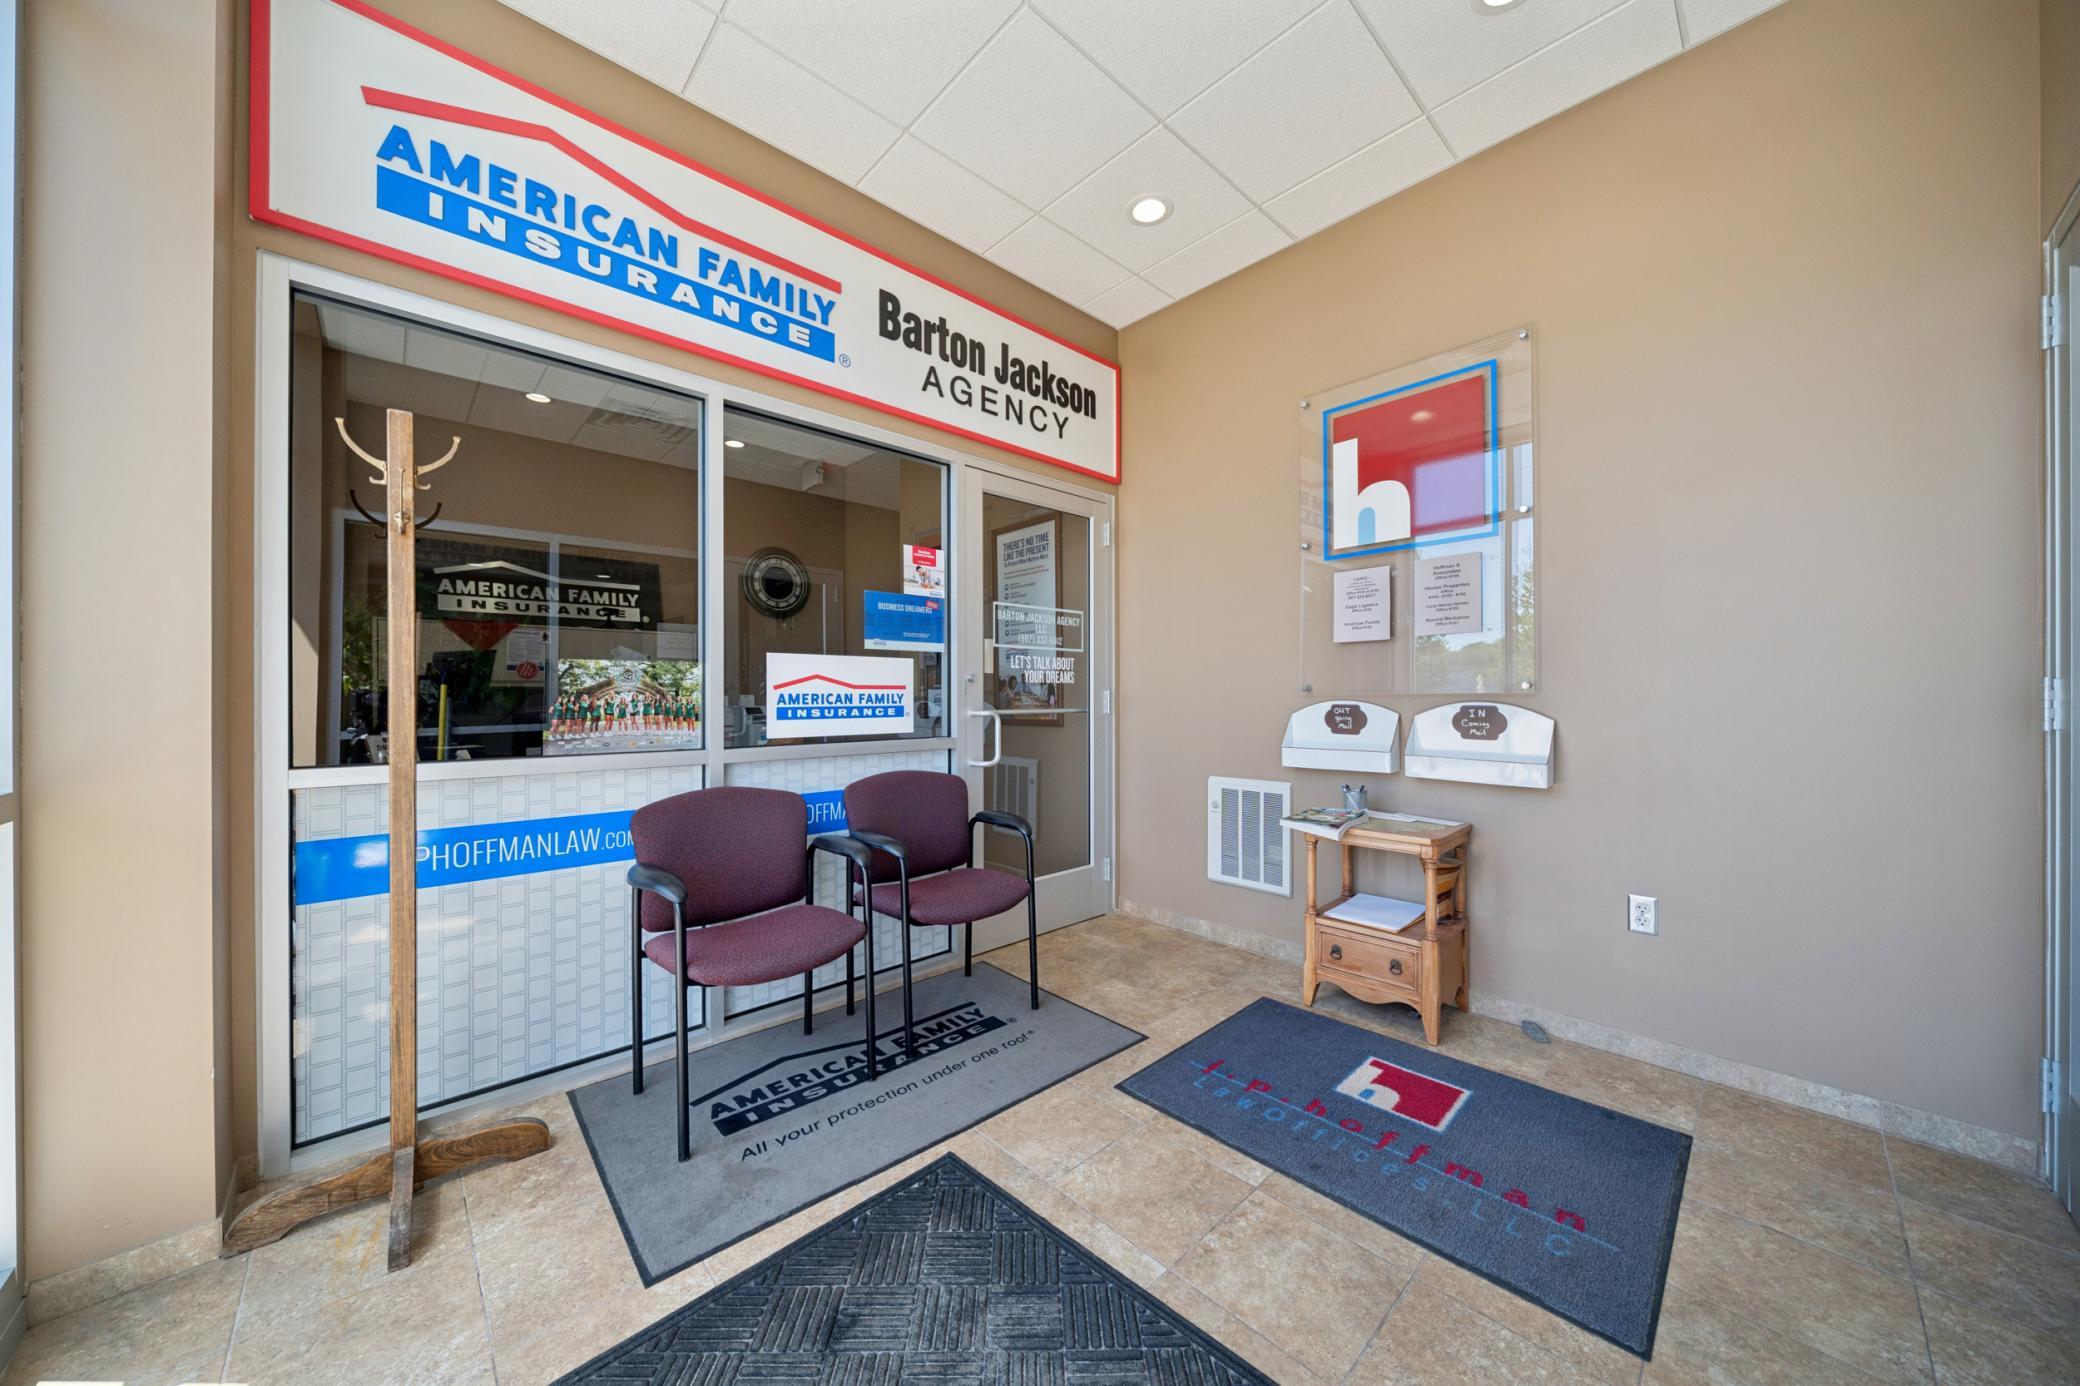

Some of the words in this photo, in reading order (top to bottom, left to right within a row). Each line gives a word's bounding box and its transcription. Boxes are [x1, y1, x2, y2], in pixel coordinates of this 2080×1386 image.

[376, 125, 678, 269] AMERICAN
[699, 247, 836, 326] FAMILY
[428, 191, 811, 348] INSURANCE
[879, 288, 985, 377] Barton
[994, 342, 1097, 420] Jackson
[921, 365, 1069, 439] AGENCY
[1003, 538, 1025, 552] THERE'S
[1026, 536, 1034, 546] NO
[1035, 532, 1049, 545] TIME
[1003, 551, 1015, 562] LIKE
[1016, 548, 1025, 559] THE
[1026, 543, 1050, 557] PRESENT
[438, 578, 559, 602] AMERICAN
[568, 588, 639, 607] FAMILY
[456, 598, 627, 618] INSURANCE
[877, 601, 904, 612] BUSINESS
[997, 609, 1025, 622] BARTON
[1027, 612, 1056, 625] JACKSON
[1057, 615, 1081, 627] AGENCY
[1035, 623, 1047, 634] LLC
[1010, 654, 1032, 669] LET'S
[1032, 656, 1051, 670] TALK
[1052, 657, 1075, 671] ABOUT
[1024, 669, 1045, 684] YOUR
[1045, 671, 1075, 684] DREAMS
[777, 692, 853, 706] AMERICAN
[858, 692, 905, 705] FAMILY
[787, 707, 896, 718] INSURANCE
[1469, 728, 1487, 737] Mail
[711, 1047, 887, 1120] AMERICAN
[891, 1007, 985, 1050] FAMILY
[748, 1024, 987, 1122] INSURANCE
[741, 1141, 768, 1161] All
[775, 1120, 820, 1146] your
[827, 1081, 918, 1127] protection
[921, 1060, 968, 1085] under
[971, 1045, 1000, 1064] one
